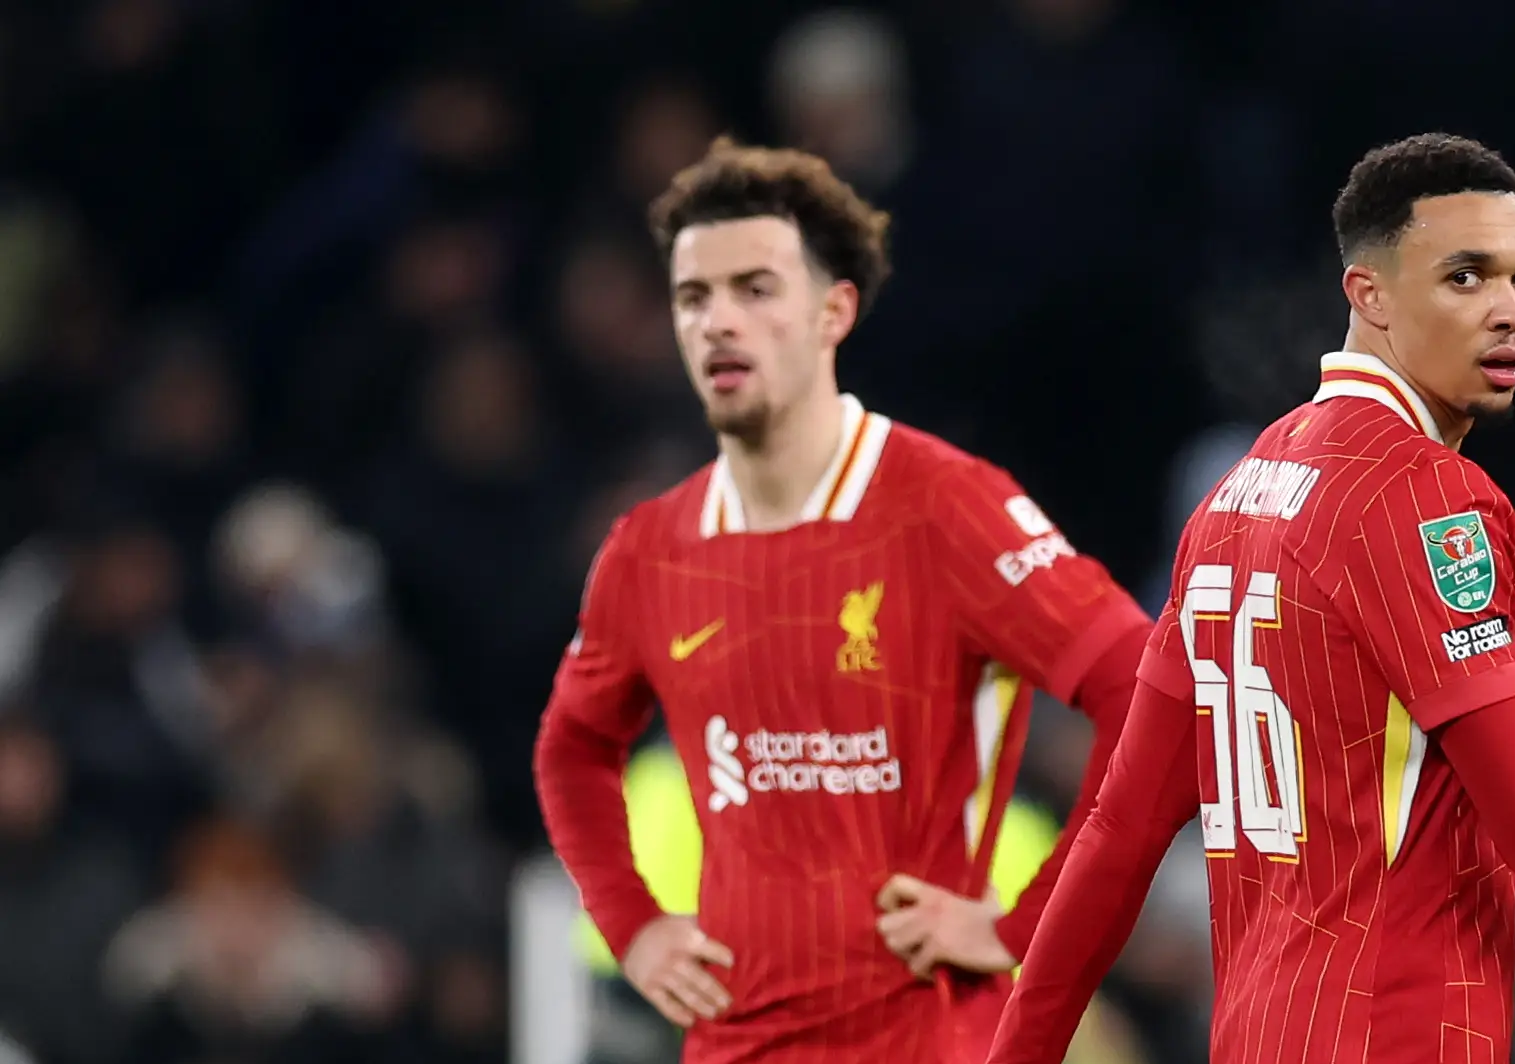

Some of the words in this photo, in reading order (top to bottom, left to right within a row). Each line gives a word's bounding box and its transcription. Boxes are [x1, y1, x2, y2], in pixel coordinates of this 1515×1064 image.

[1436, 548, 1487, 580] Carabao
[1454, 566, 1480, 586] Cup
[1441, 629, 1470, 648] No
[749, 758, 902, 795] charered
